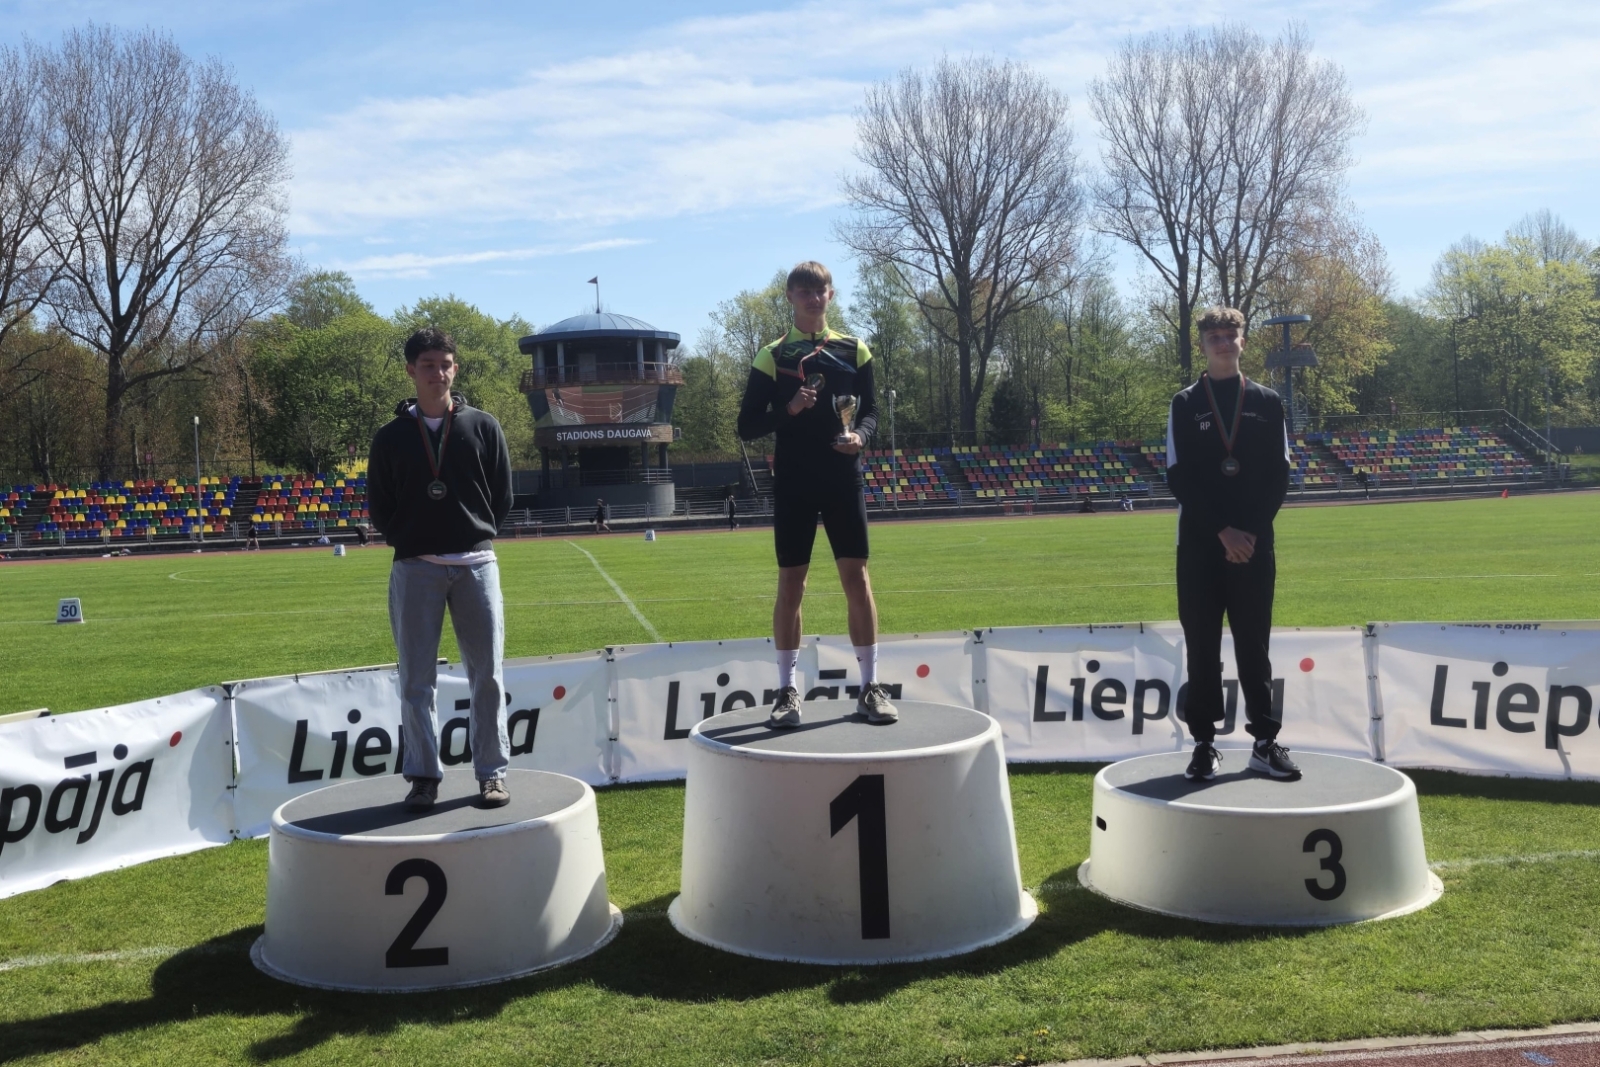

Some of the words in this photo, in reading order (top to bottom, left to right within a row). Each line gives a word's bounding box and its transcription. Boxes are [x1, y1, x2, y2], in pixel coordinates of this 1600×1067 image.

[556, 430, 604, 441] STADIONS
[607, 428, 652, 438] DAUGAVA
[1200, 421, 1211, 431] RP
[61, 605, 77, 618] 50
[1033, 659, 1285, 735] Liepj
[1430, 661, 1600, 750] Liep
[288, 692, 541, 784] Lieāa
[829, 774, 891, 940] 1
[1302, 828, 1347, 902] 3
[385, 858, 449, 969] 2
